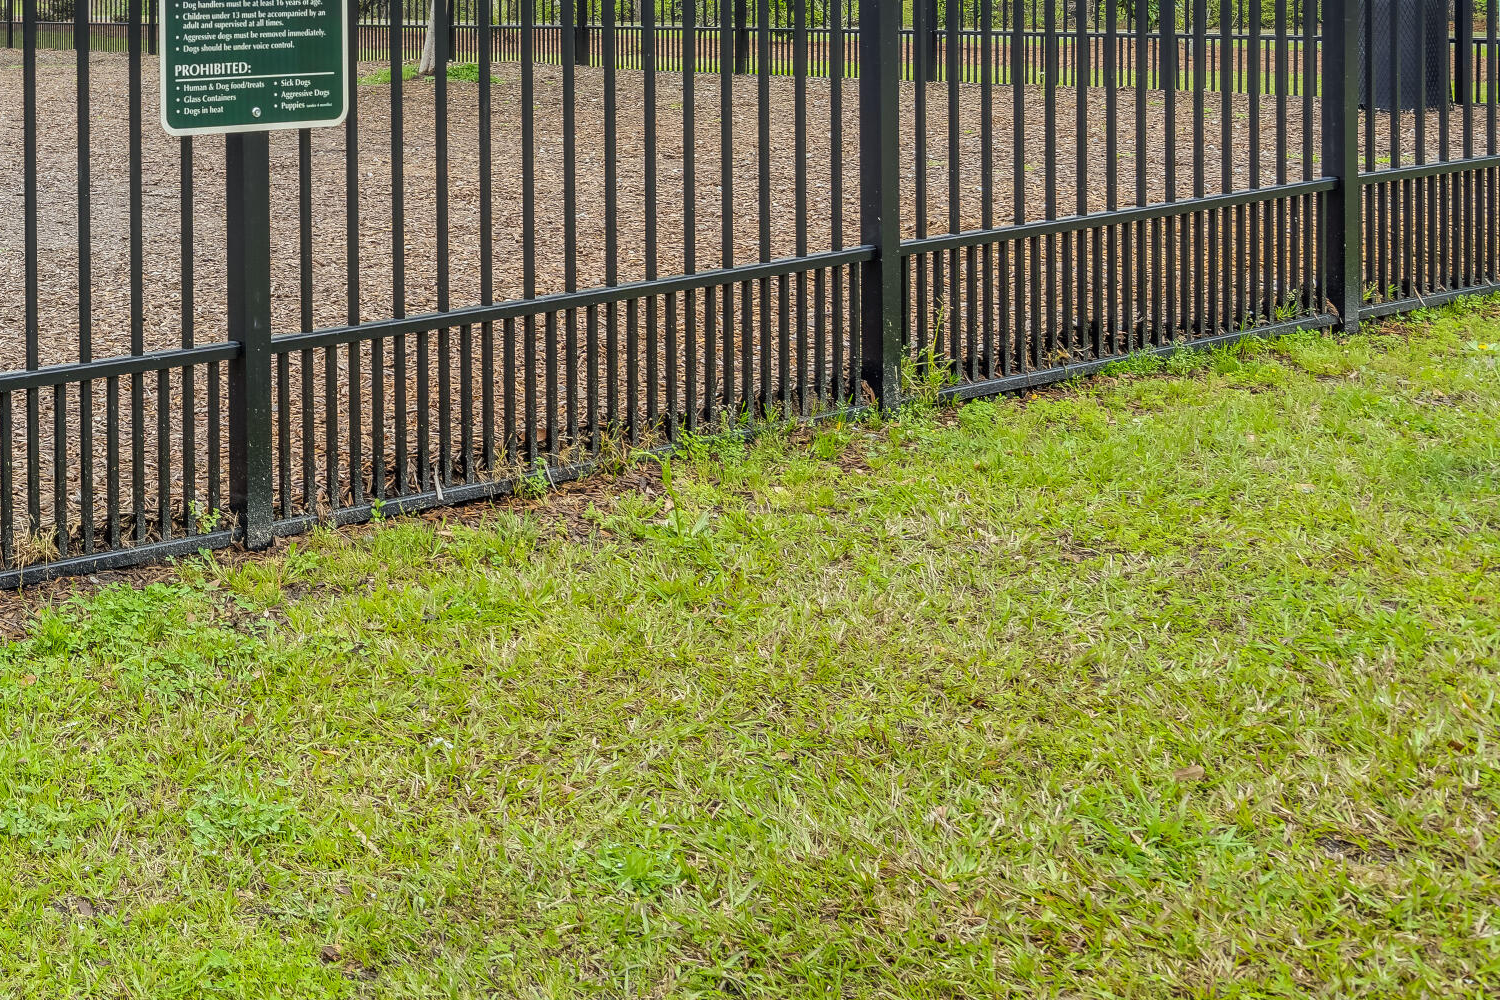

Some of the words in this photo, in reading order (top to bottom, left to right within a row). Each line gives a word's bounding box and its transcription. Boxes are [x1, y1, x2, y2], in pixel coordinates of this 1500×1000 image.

[183, 2, 197, 11] Dog
[198, 0, 225, 9] handlers
[243, 0, 252, 8] be
[260, 0, 275, 7] least
[286, 0, 302, 8] years
[183, 13, 211, 21] Children
[212, 12, 231, 20] under
[267, 9, 308, 19] accompanied
[309, 9, 317, 18] by
[183, 22, 200, 30] adult
[201, 21, 213, 29] and
[214, 20, 248, 30] supervised
[248, 20, 255, 28] at
[256, 19, 265, 27] all
[266, 19, 284, 27] times.
[183, 33, 217, 43] Aggressive
[218, 32, 233, 42] dogs
[250, 31, 259, 39] be
[260, 30, 287, 38] removed
[288, 29, 326, 38] immediately.
[183, 45, 200, 54] Dogs
[201, 44, 223, 52] should
[233, 43, 252, 51] under
[253, 42, 270, 50] voice
[271, 41, 295, 49] control.
[175, 62, 252, 77] PROHIBITED:
[216, 83, 230, 92] Dog
[231, 81, 265, 90] food/treats
[281, 79, 294, 87] Sick
[295, 79, 311, 88] Dogs
[184, 96, 202, 104] Glass
[202, 94, 237, 103] Containers
[281, 90, 314, 100] Aggressive
[314, 89, 330, 98] Dogs
[184, 108, 201, 116] Dogs
[202, 106, 209, 114] in
[210, 106, 224, 114] heat
[281, 101, 306, 111] Puppies
